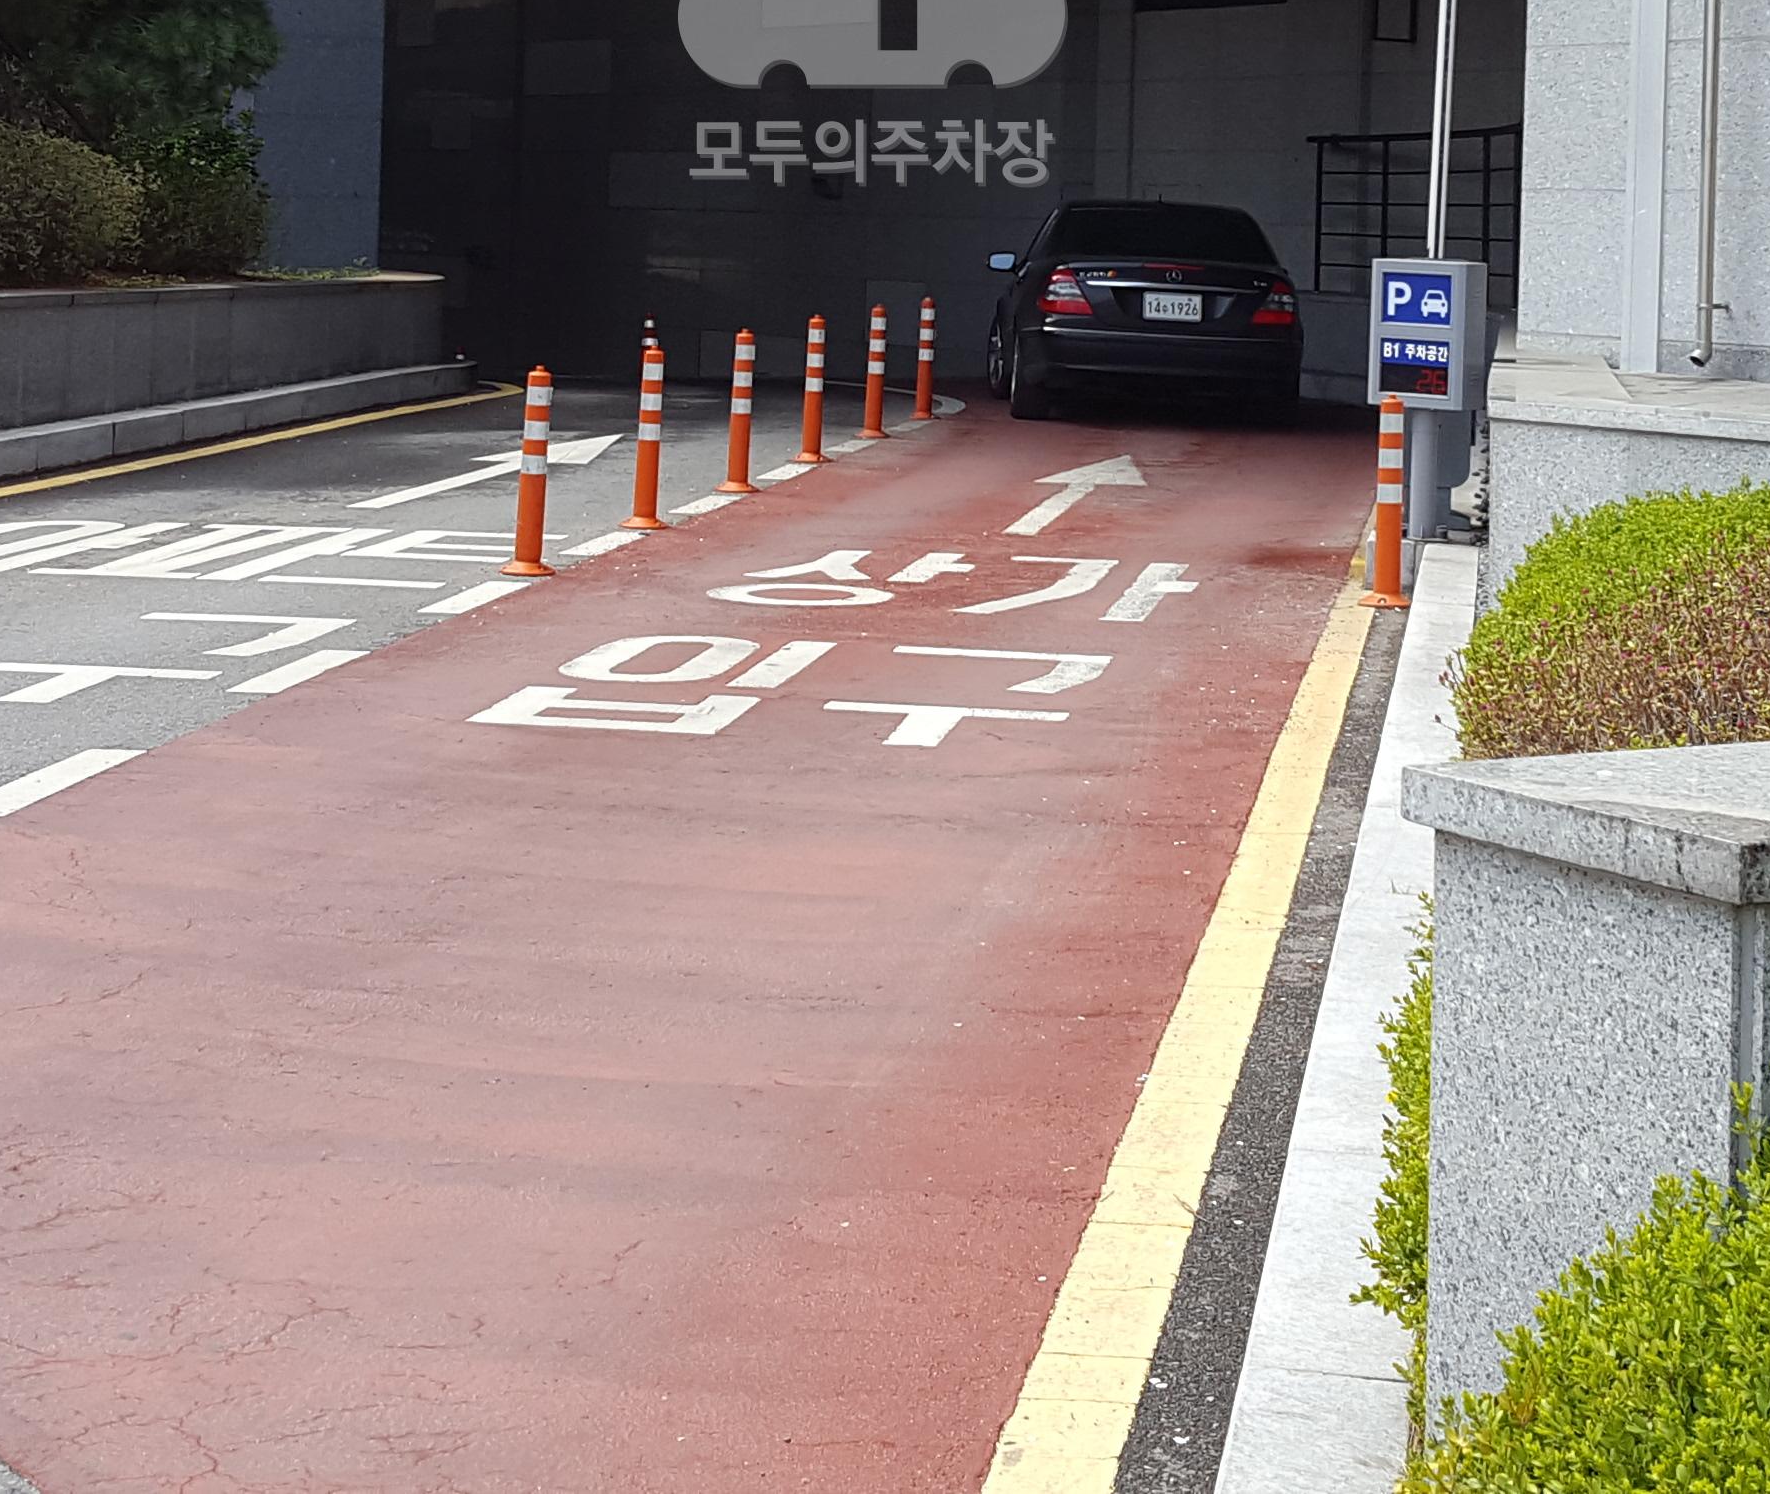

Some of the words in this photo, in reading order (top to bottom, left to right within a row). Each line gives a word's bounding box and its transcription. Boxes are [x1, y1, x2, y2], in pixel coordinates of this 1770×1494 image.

[1386, 280, 1412, 316] P
[1383, 342, 1400, 359] B1
[1405, 343, 1448, 363] 주차공간
[706, 550, 1199, 622] 상가
[465, 635, 1114, 747] 입구
